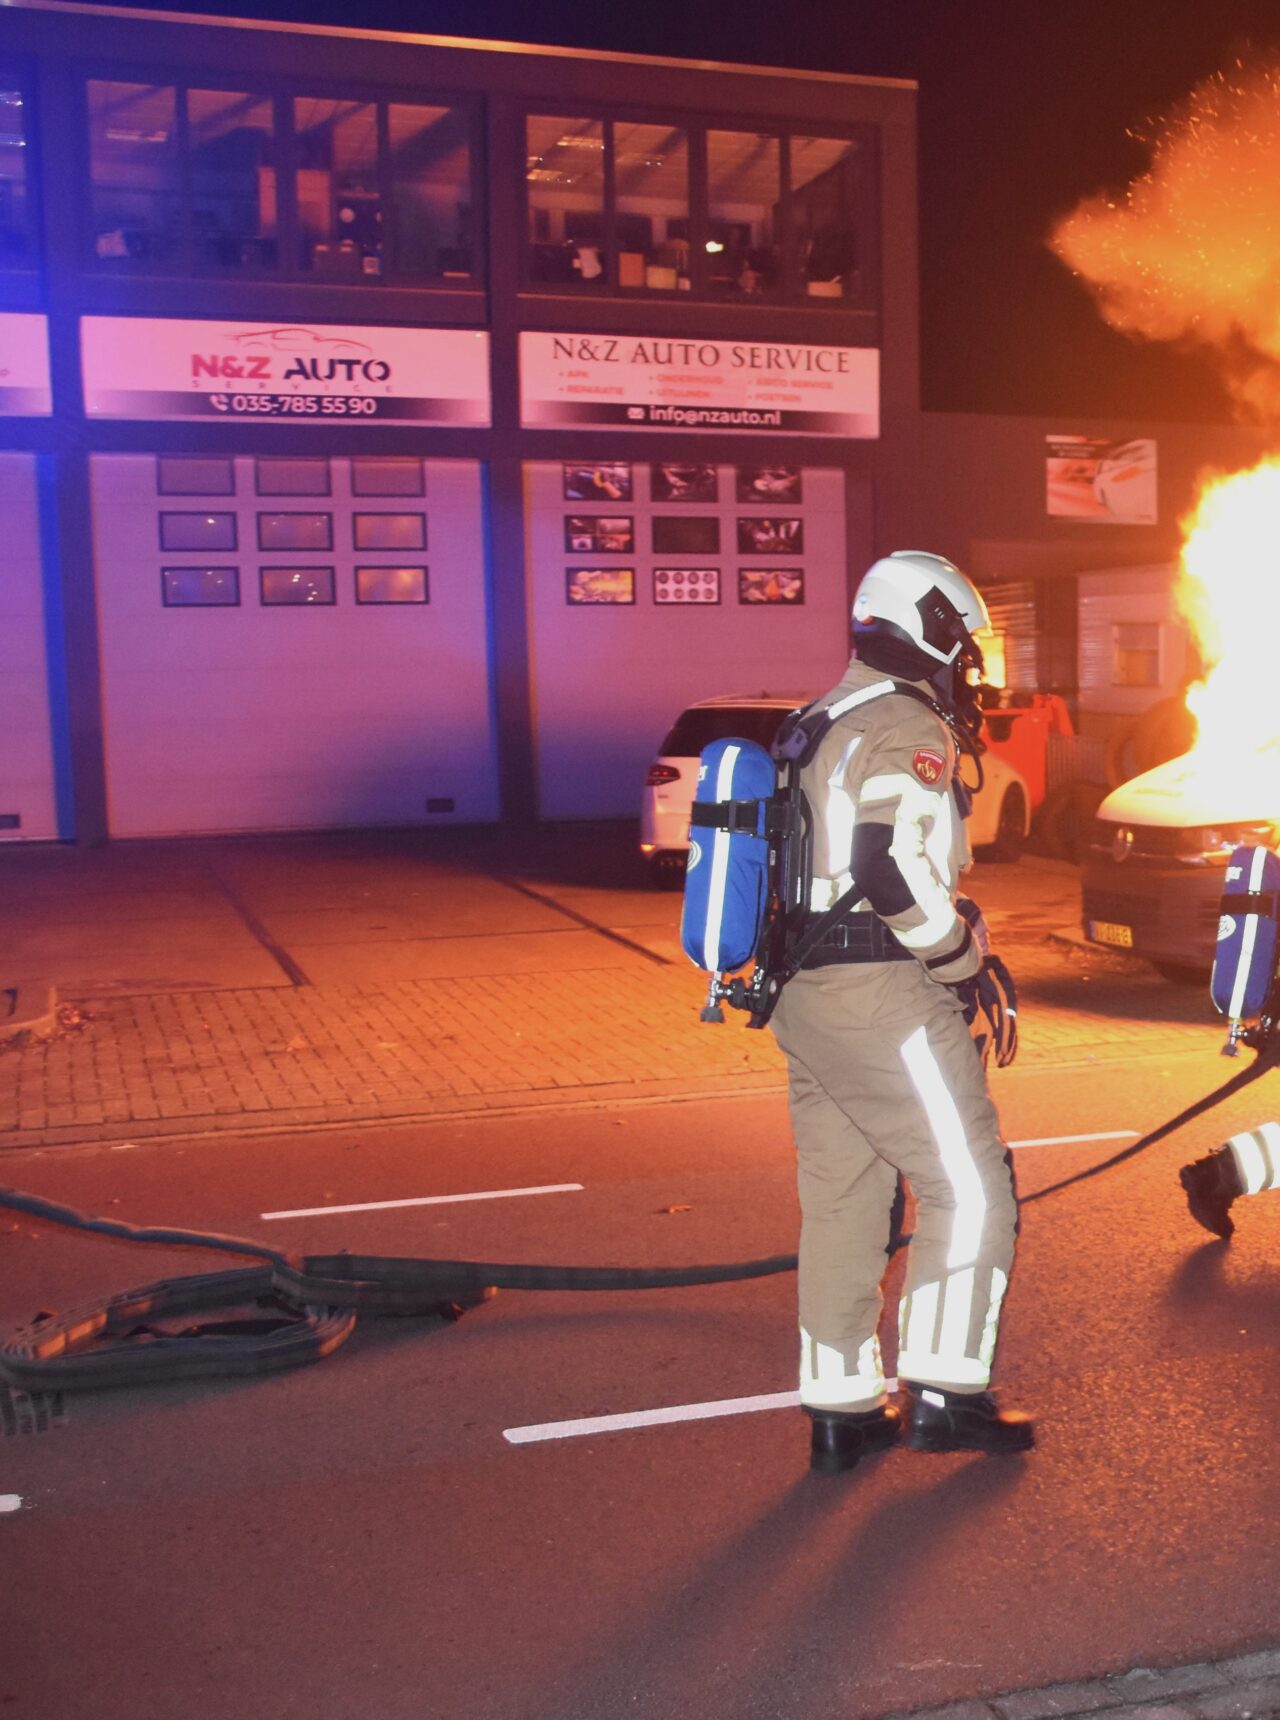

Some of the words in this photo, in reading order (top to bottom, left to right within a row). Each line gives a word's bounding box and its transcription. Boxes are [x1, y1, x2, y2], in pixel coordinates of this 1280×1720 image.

[551, 336, 621, 364] N&Z
[630, 340, 721, 369] AUTO
[730, 348, 851, 374] SERVICE
[191, 353, 273, 380] N&Z
[282, 357, 391, 383] AUTO
[192, 378, 392, 394] SERVICE
[649, 405, 782, 426] info@nzauto.nl
